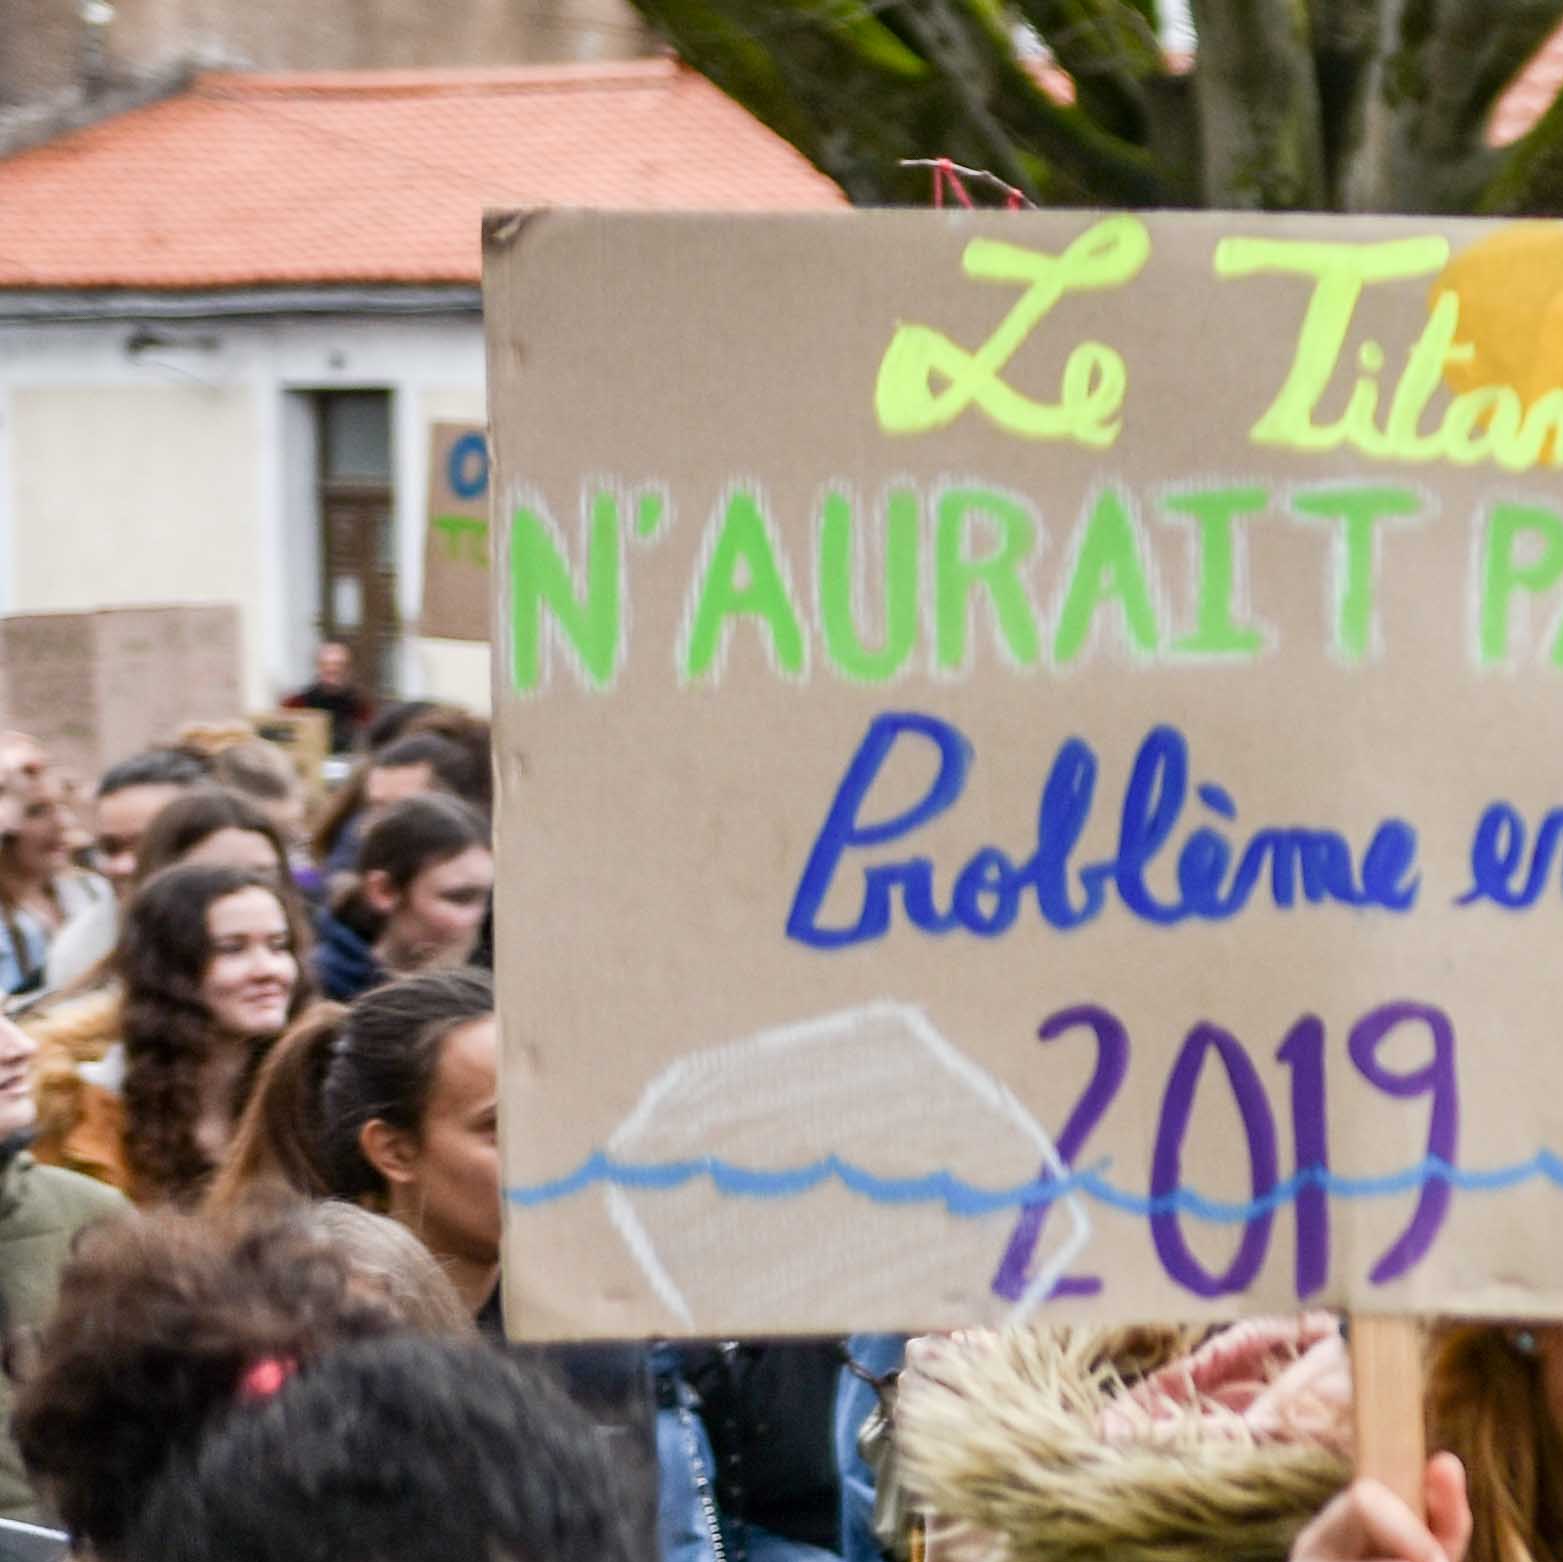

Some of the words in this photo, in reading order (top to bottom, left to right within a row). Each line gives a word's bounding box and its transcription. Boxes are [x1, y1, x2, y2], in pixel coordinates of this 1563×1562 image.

[872, 213, 1151, 449] Le
[506, 482, 1430, 694] N'AURAIT
[783, 711, 1421, 949] Problème
[991, 998, 1460, 1301] 2019
